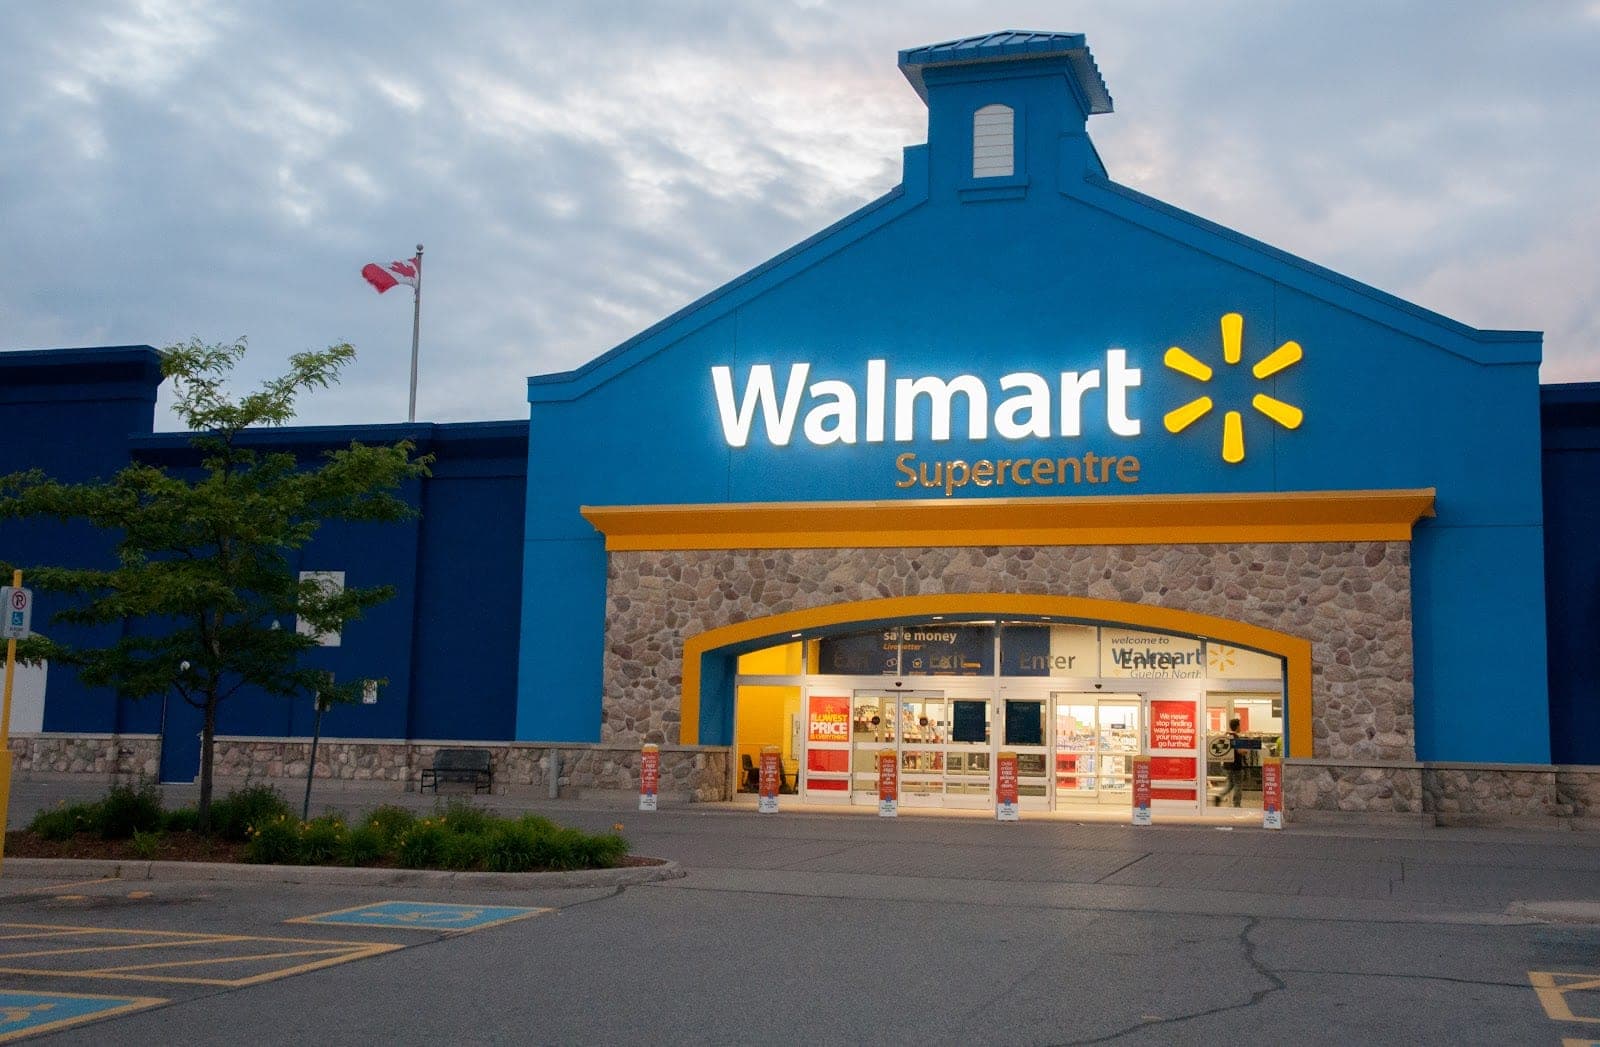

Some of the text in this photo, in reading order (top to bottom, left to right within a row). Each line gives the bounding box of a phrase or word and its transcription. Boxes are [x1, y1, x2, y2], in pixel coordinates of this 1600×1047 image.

[711, 349, 1141, 447] Walmart
[895, 452, 1141, 496] Supercentre
[914, 631, 957, 643] money
[1111, 636, 1170, 645] welcome to
[1020, 652, 1076, 670] Enter
[1111, 648, 1203, 665] Walmart
[1121, 651, 1178, 669] Enter
[1171, 669, 1202, 679] North
[811, 722, 848, 735] PRICE
